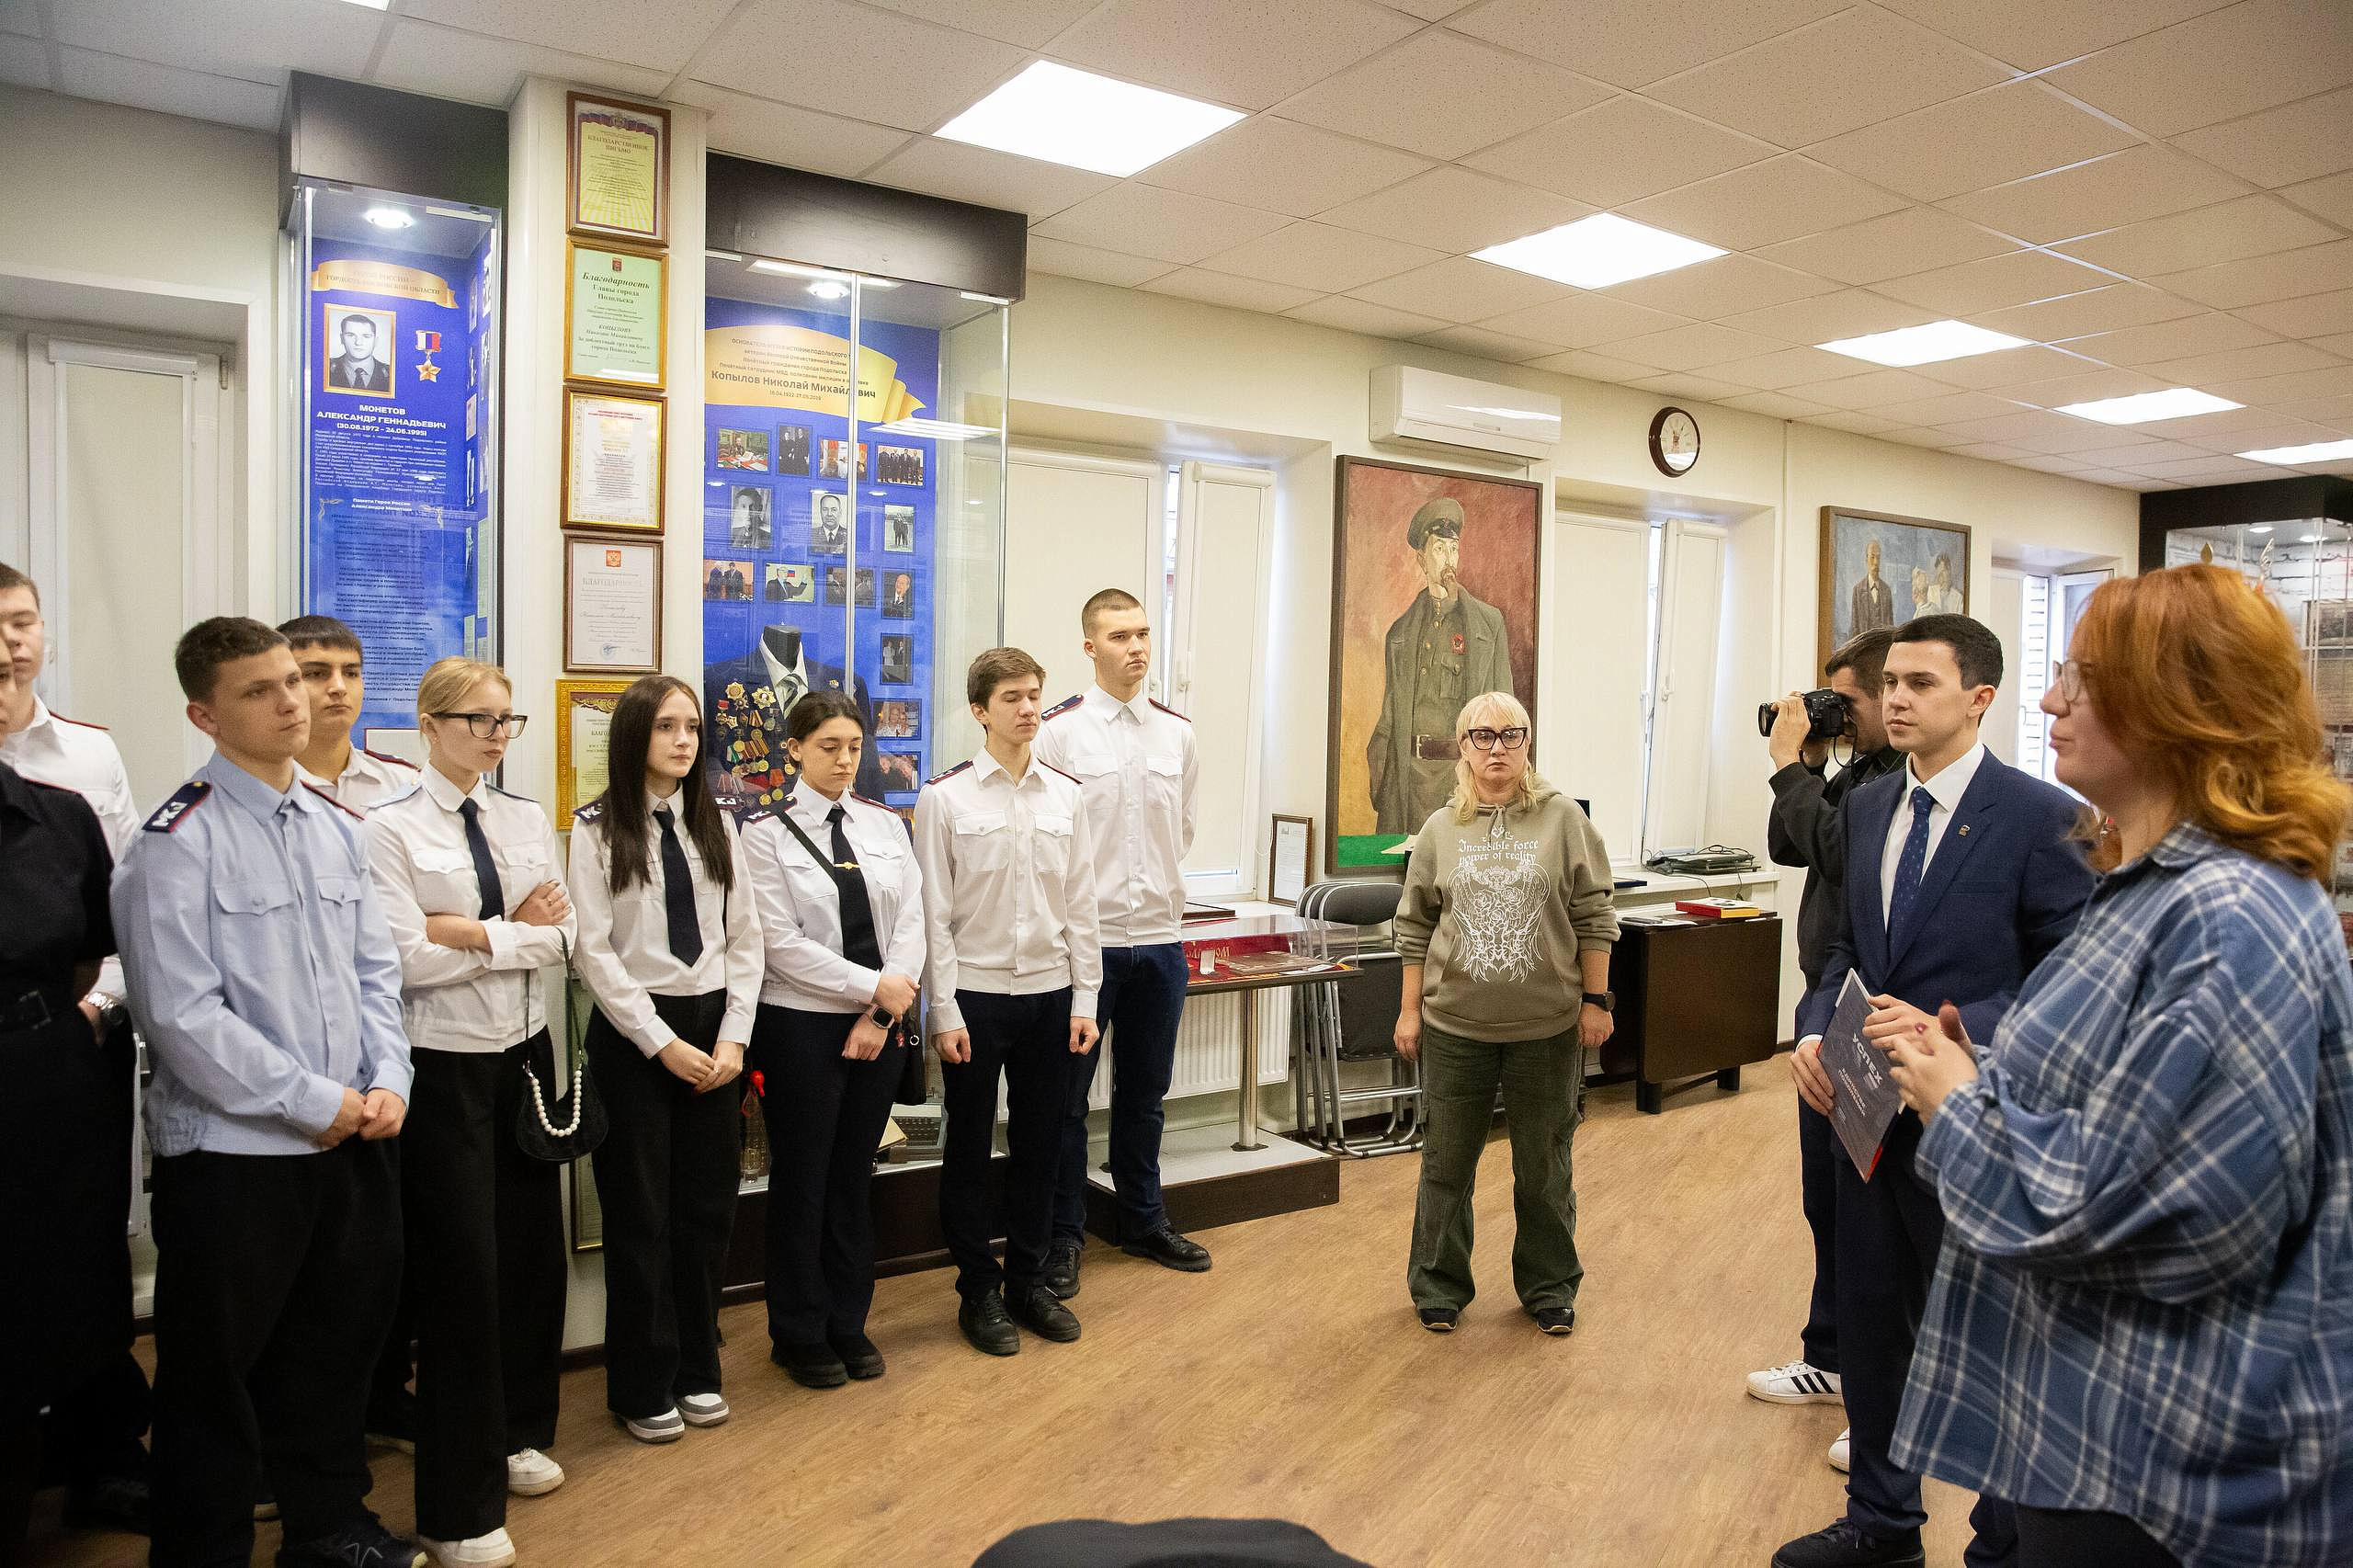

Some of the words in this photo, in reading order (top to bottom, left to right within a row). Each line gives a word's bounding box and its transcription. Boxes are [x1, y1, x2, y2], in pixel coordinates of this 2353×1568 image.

[582, 272, 650, 289] Благодарность
[711, 369, 761, 384] Копылов
[763, 376, 809, 391] Николай
[811, 382, 876, 398] Михайлвич
[358, 404, 406, 415] МОНЕТОВ
[316, 411, 377, 423] АЛЕКСАНДР
[378, 416, 447, 429] ГЕННАДЬЕВИЧ
[336, 423, 380, 432] (30.08.1972
[1458, 839, 1509, 853] Incredible
[1514, 840, 1539, 851] force
[1459, 853, 1489, 868] power
[1492, 850, 1502, 861] of
[1506, 851, 1537, 864] reality
[1852, 1032, 1883, 1085] УСПЕХ
